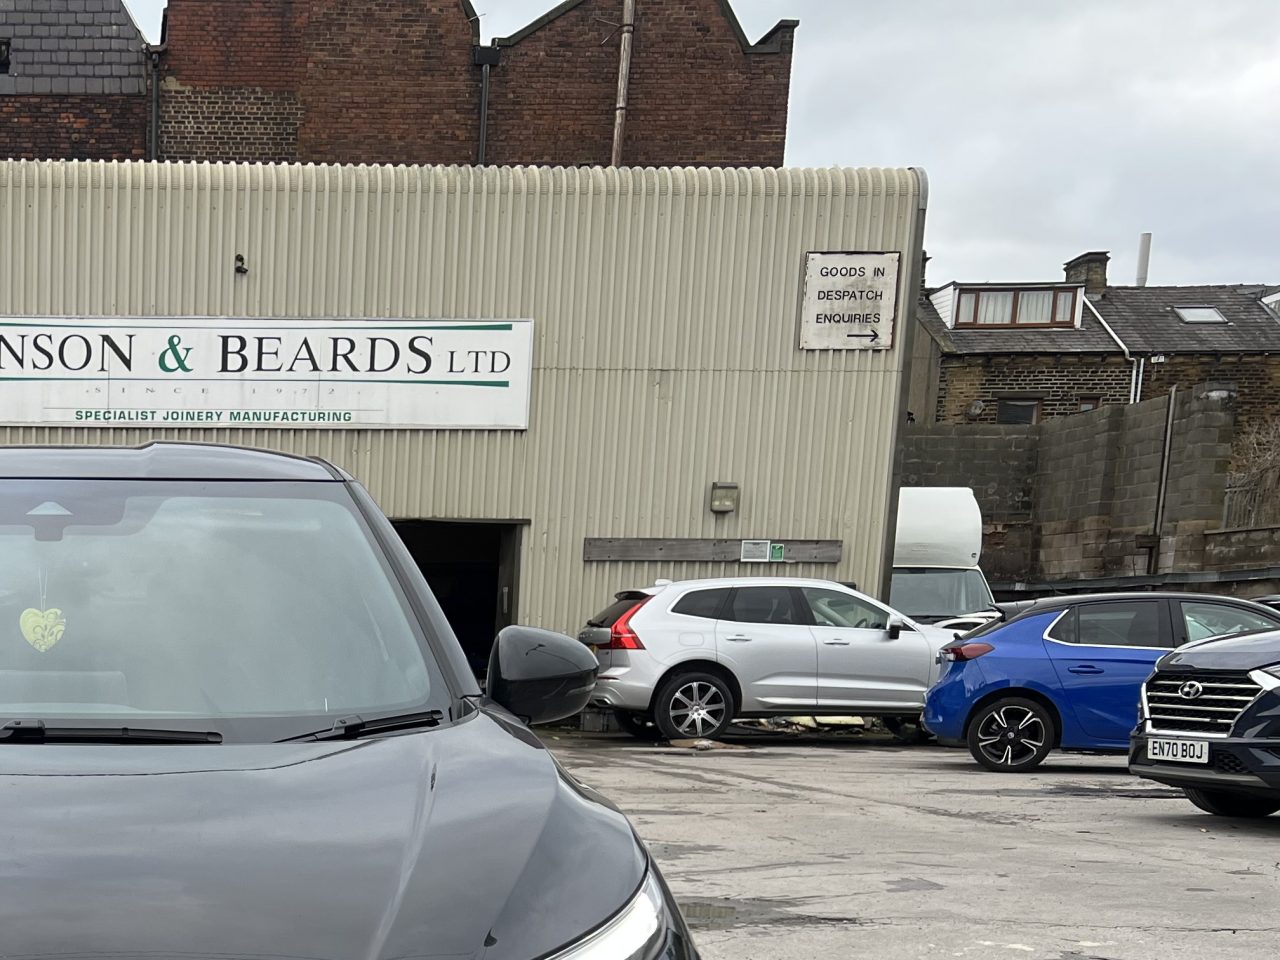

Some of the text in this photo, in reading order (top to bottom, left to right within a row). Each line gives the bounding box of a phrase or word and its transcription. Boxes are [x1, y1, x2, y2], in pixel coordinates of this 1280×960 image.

[820, 266, 886, 277] GOODS IN
[817, 290, 883, 301] DESPATCH
[815, 313, 881, 324] ENQUIRIES
[158, 334, 194, 373] &
[216, 334, 434, 374] BEARDS
[447, 350, 511, 373] LTD
[75, 410, 352, 422] SPECIALIST JOINERY MANUFACTURING
[1151, 740, 1203, 759] EN70 BOJ
